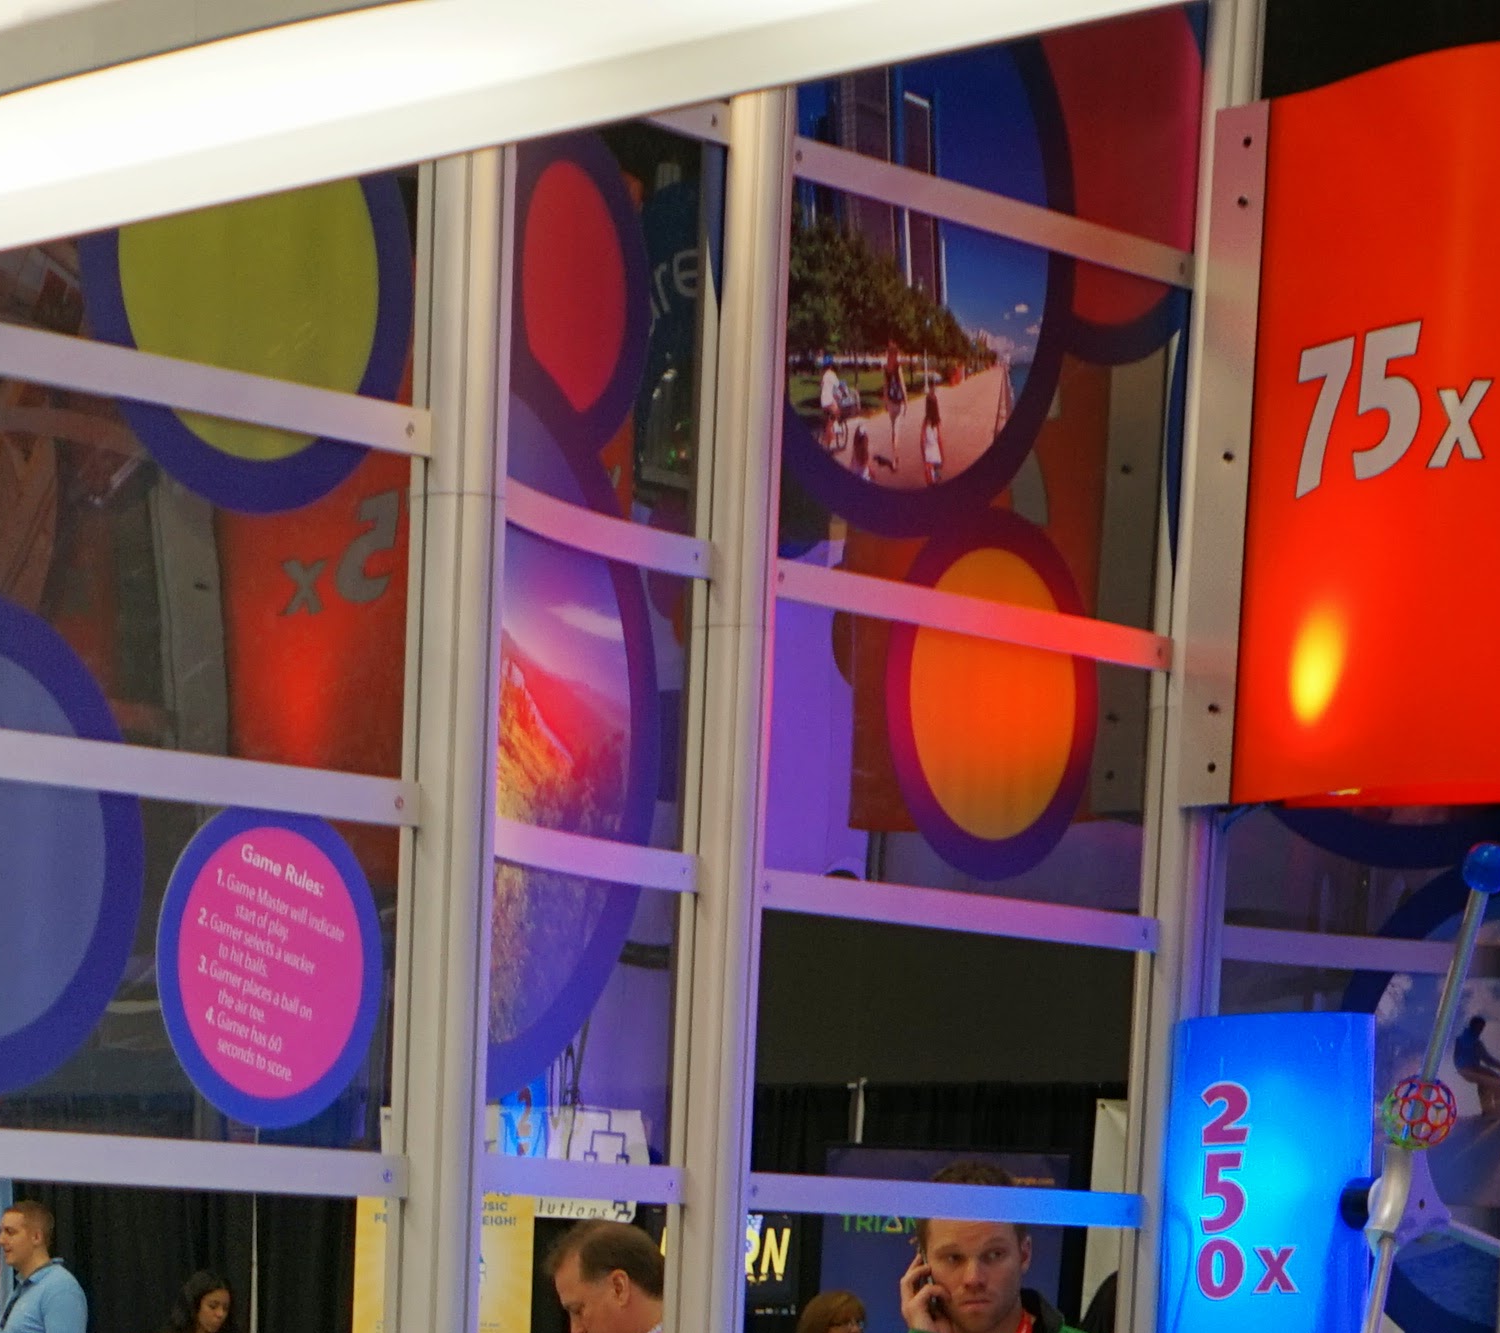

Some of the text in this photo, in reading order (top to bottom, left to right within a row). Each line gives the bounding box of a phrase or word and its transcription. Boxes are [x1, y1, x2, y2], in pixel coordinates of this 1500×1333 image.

[1296, 319, 1494, 500] 75x
[241, 843, 325, 898] Game Rules:
[217, 868, 346, 944] 1. Game Master will indicate
[235, 903, 255, 924] start
[256, 911, 269, 928] of
[198, 907, 209, 928] 2.
[210, 913, 243, 941] Gamer
[243, 932, 275, 958] selects
[219, 942, 229, 961] to
[229, 946, 244, 968] hit
[198, 954, 208, 974] 3.
[209, 959, 242, 989] Gamer
[242, 978, 273, 1004] places
[280, 991, 299, 1016] ball
[299, 1004, 313, 1022] on
[218, 989, 235, 1010] the
[234, 1000, 249, 1016] air
[205, 1006, 282, 1054] 4. Gamer has 60
[217, 1038, 255, 1067] seconds
[256, 1053, 267, 1071] to
[539, 1199, 609, 1219] lutions
